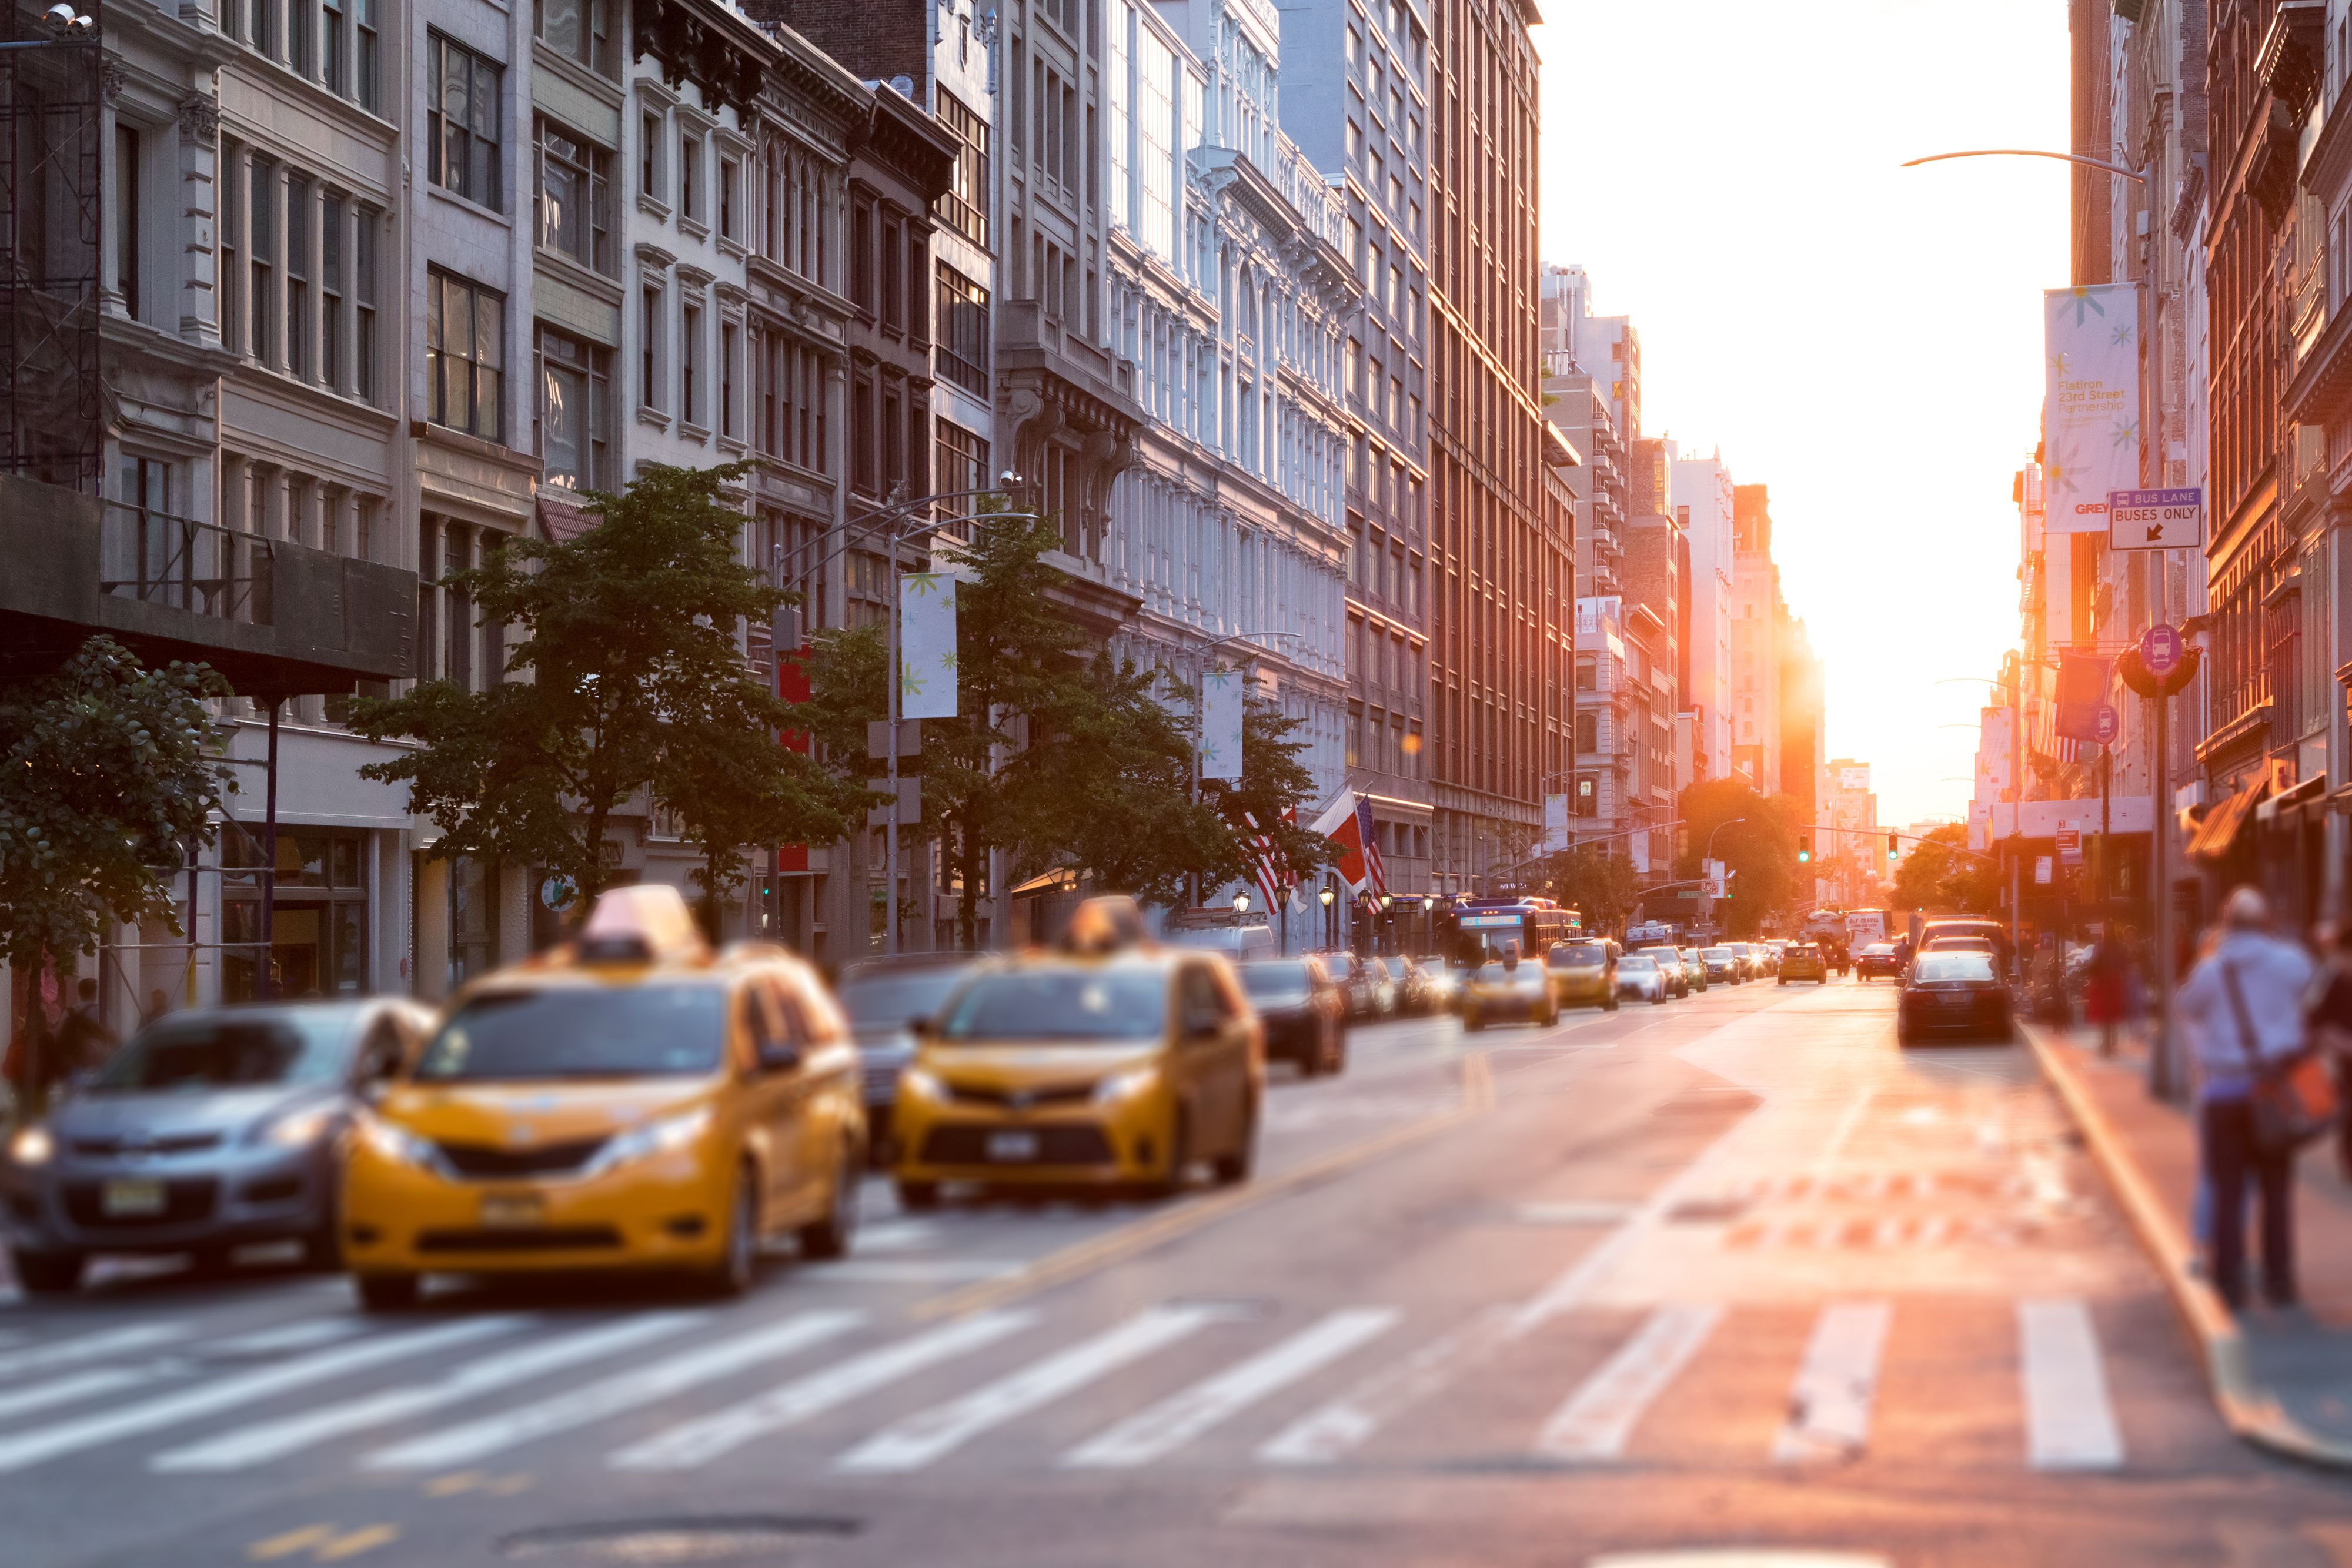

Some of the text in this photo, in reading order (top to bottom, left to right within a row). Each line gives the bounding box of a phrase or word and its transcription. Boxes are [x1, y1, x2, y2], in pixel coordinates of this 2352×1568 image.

[2058, 380, 2103, 391] Flatiron
[2059, 389, 2125, 402] 23rd Street
[2058, 400, 2124, 414] Partnership
[2135, 492, 2195, 504] BUS LANE
[2075, 503, 2109, 514] GREY
[2116, 507, 2196, 521] BUSES ONLY
